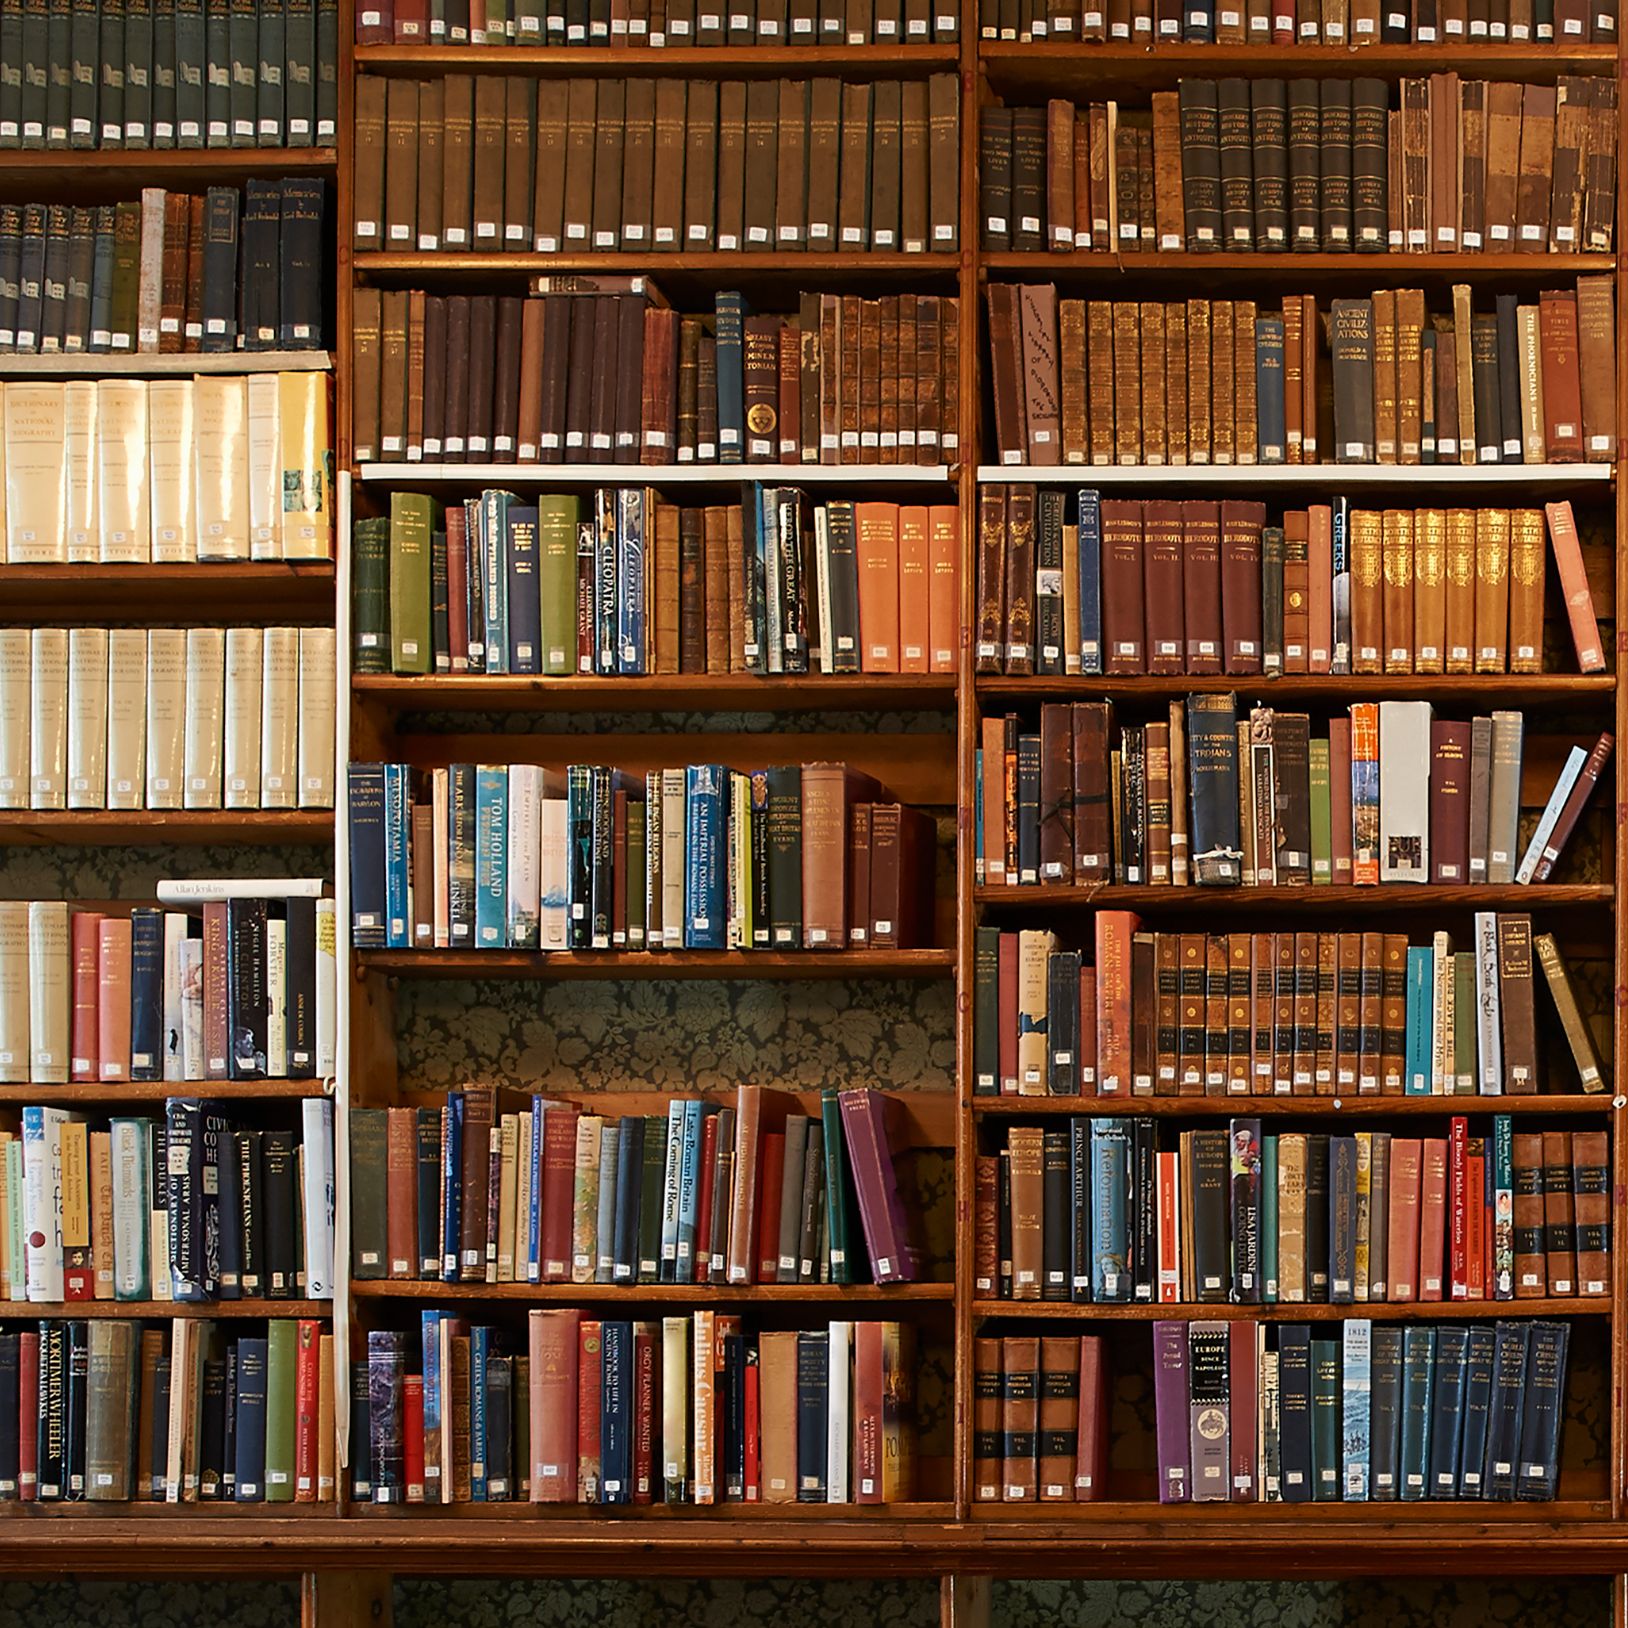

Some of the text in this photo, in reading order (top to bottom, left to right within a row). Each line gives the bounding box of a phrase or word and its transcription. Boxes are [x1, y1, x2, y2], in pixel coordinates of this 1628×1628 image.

[1336, 309, 1368, 317] ANCIENT
[1337, 330, 1369, 338] ATIONS
[1528, 335, 1537, 402] PHOENICIANS
[1044, 502, 1052, 566] CIVILIZATION
[1335, 512, 1343, 571] GREEKS
[603, 546, 614, 615] CLEOPATRA
[1195, 750, 1231, 758] TROJANS
[392, 777, 401, 863] MESOPOTAMIA
[699, 802, 708, 815] AN
[699, 820, 708, 861] IMPERIAL
[492, 797, 502, 897] TOM HOLLAND
[452, 881, 460, 920] FINKEL
[211, 918, 220, 951] KING
[211, 965, 220, 1010] KAISER
[1104, 924, 1114, 1013] ROMAN EMPIRE
[157, 1129, 165, 1204] THE DUKES
[667, 1115, 681, 1222] The Coming of Rome
[683, 1112, 696, 1213] Later Roman Britain
[1454, 1124, 1463, 1244] The Bloody Fields of Waterloo
[1100, 1148, 1116, 1250] Reformation
[1247, 1207, 1256, 1272] LISA JARDINE
[49, 1330, 61, 1459] MORTIMER WHEELER
[642, 1346, 651, 1452] ORGY PLANNER WANTED
[1265, 1354, 1277, 1390] MARX
